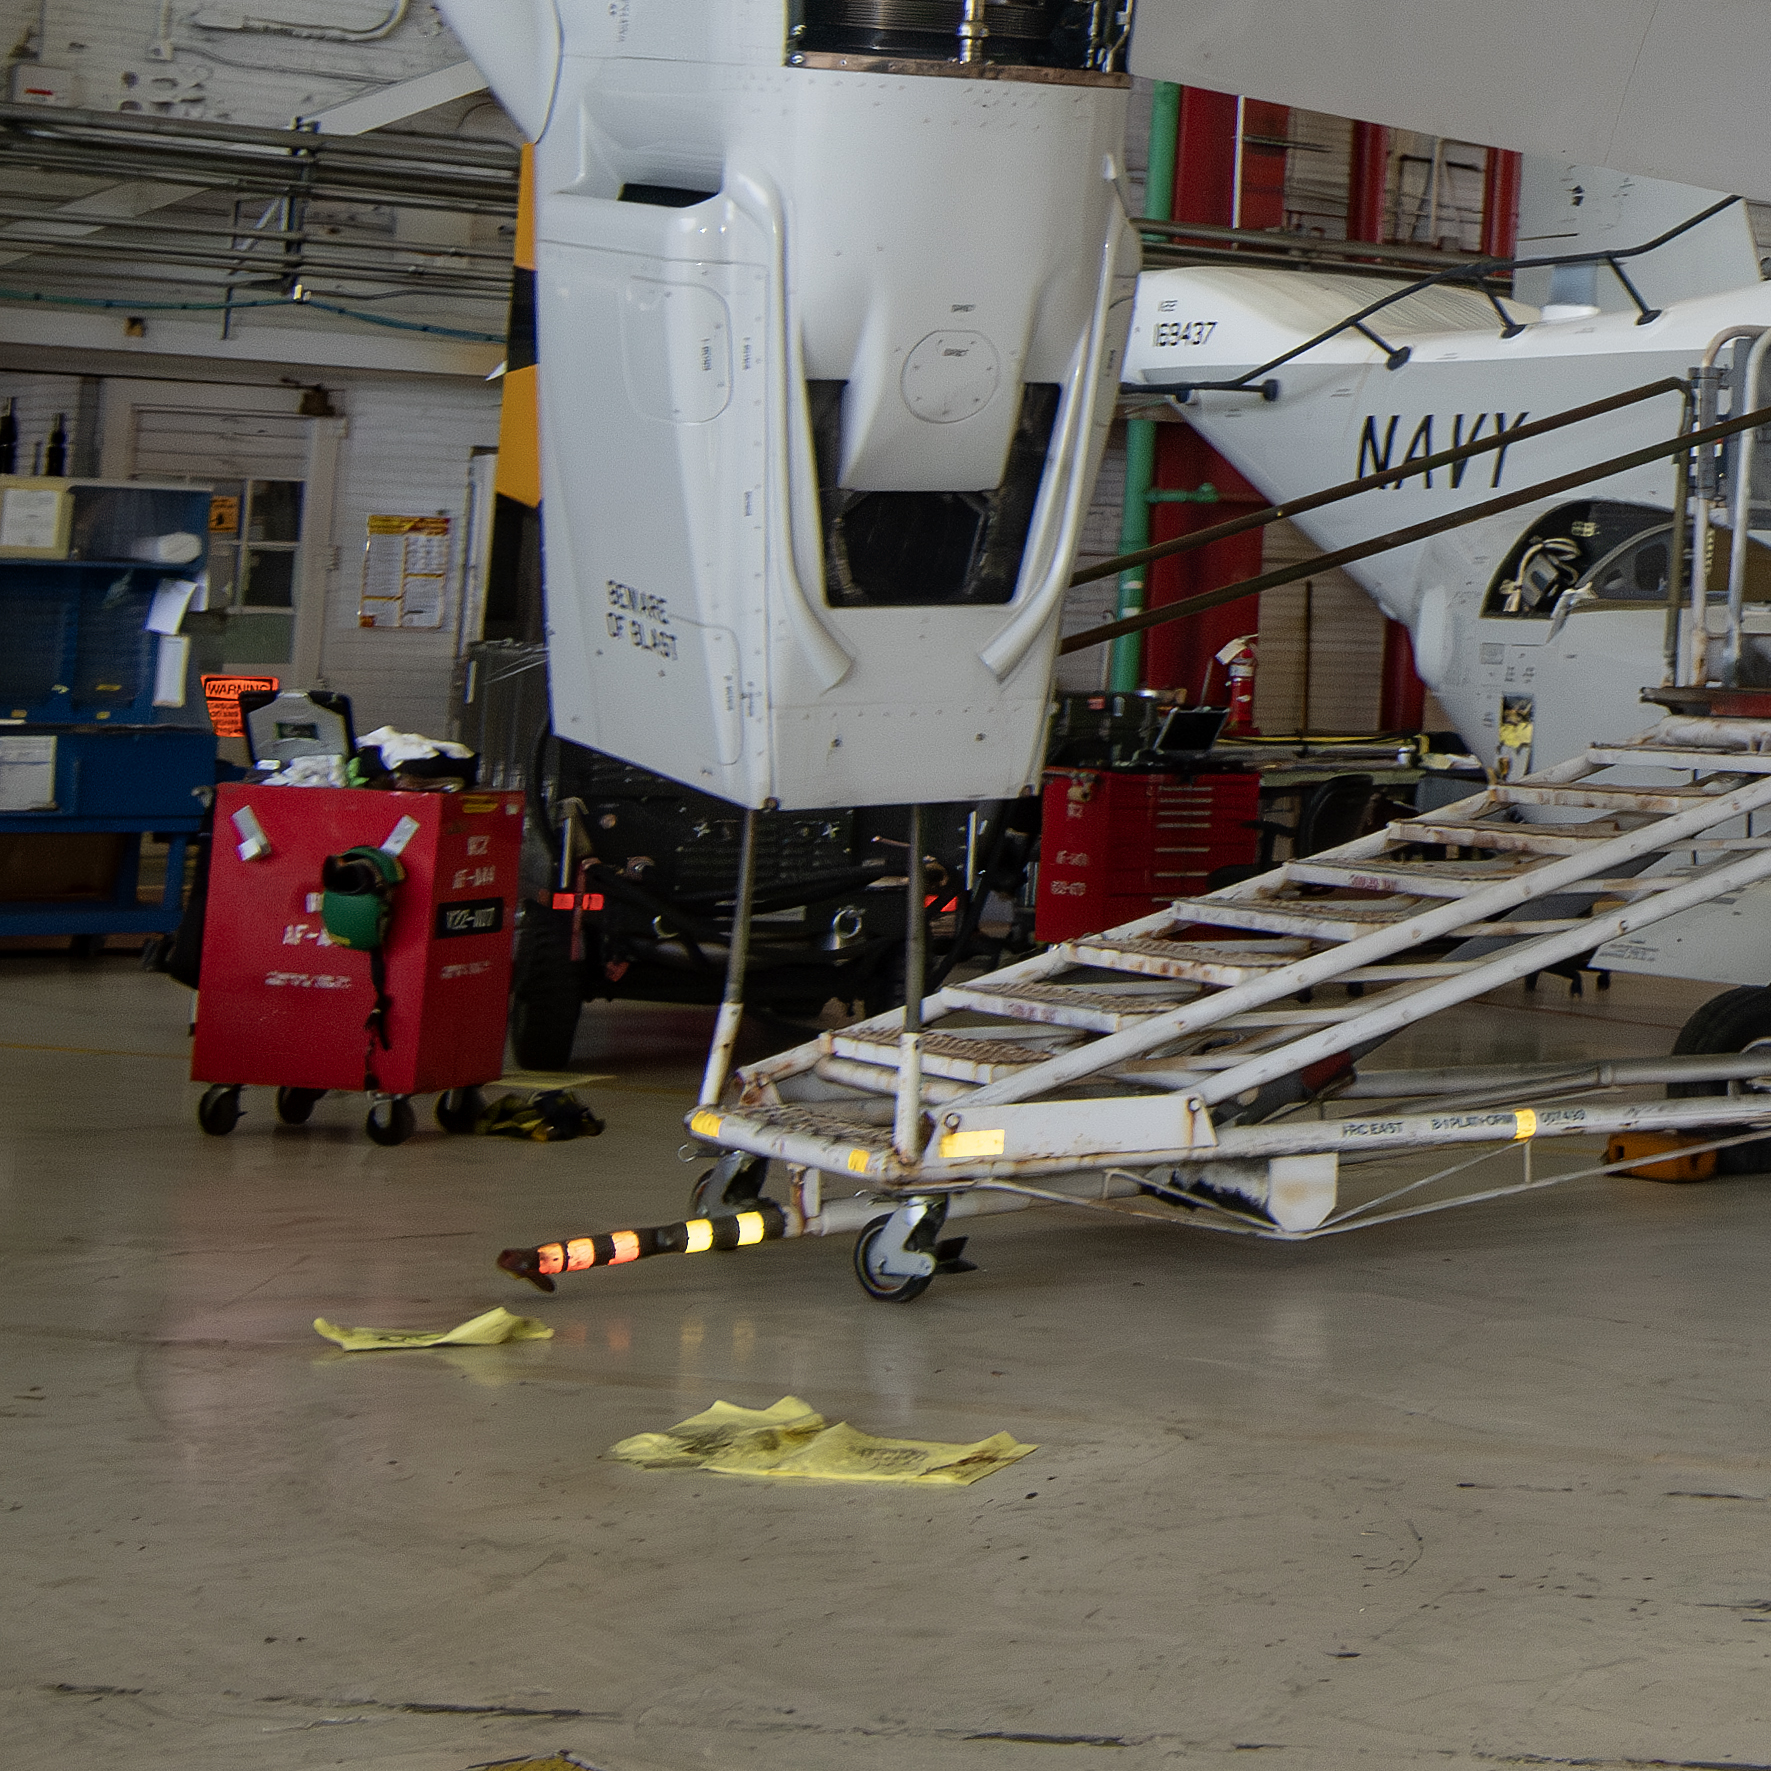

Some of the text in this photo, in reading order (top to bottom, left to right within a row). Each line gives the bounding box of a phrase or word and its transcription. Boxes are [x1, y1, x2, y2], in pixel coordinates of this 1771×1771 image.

[1355, 412, 1530, 490] NAVY
[607, 580, 669, 625] BEWARE
[607, 612, 678, 660] OF BLAST
